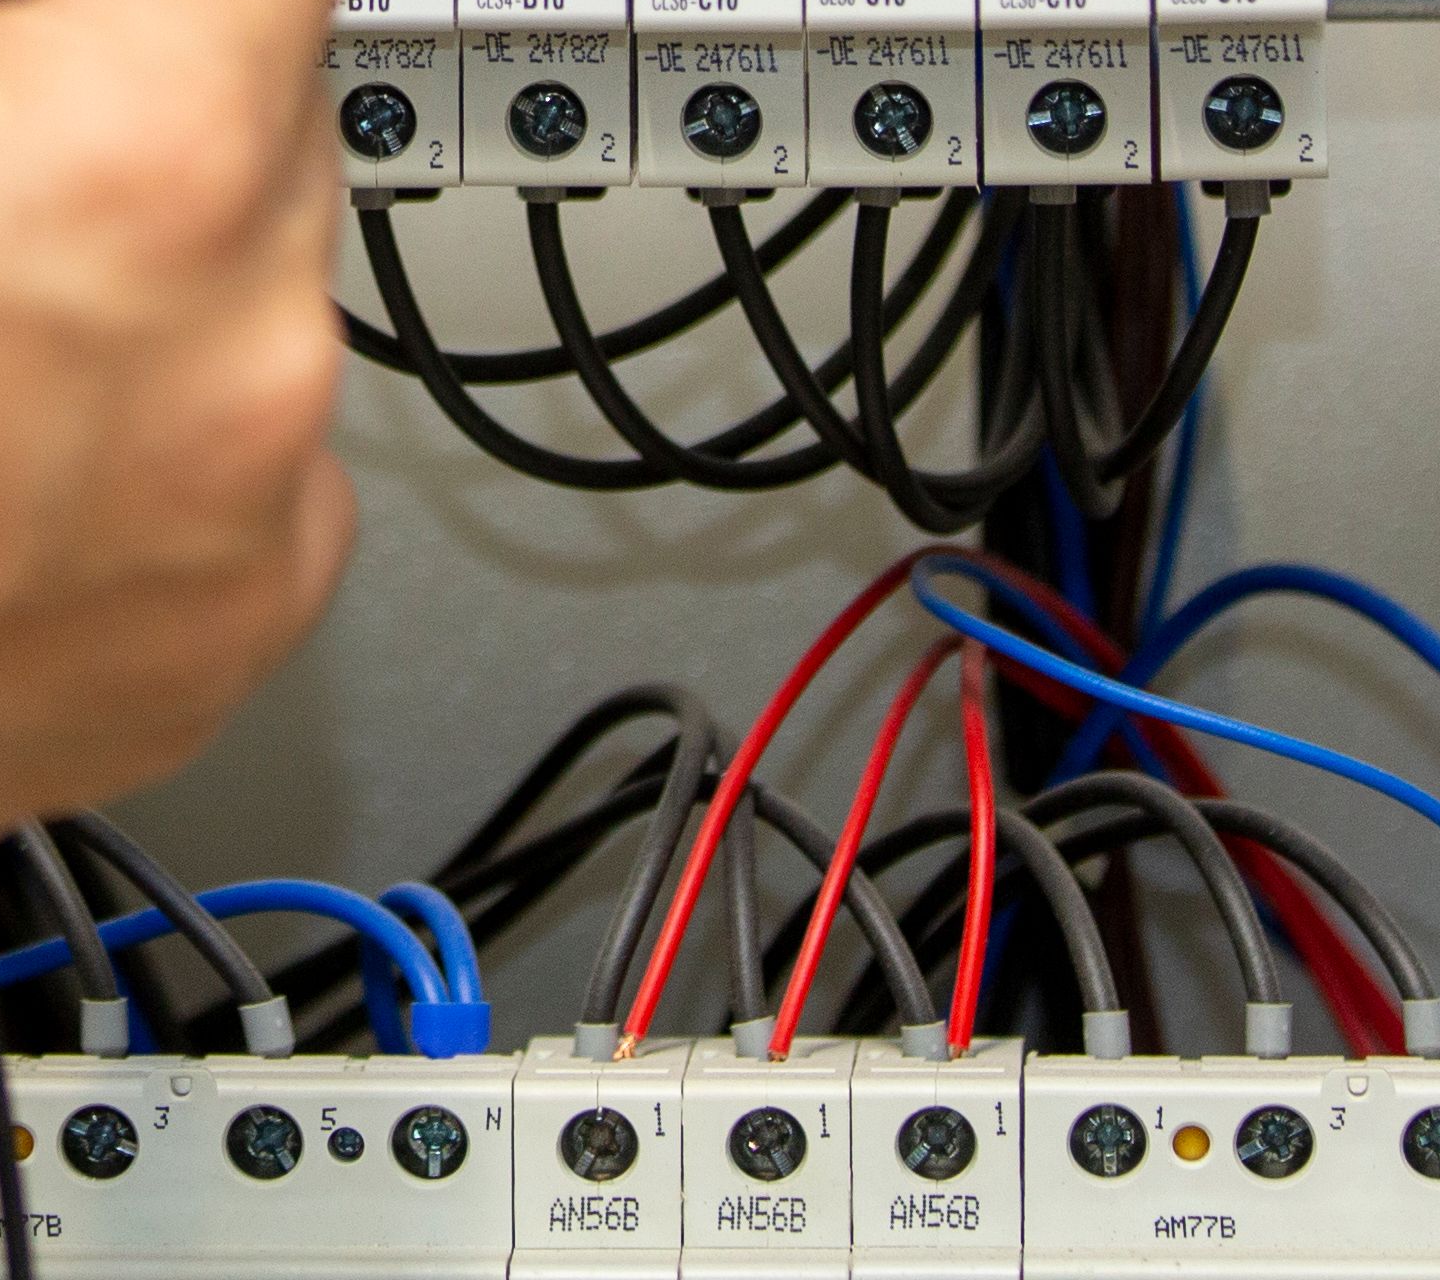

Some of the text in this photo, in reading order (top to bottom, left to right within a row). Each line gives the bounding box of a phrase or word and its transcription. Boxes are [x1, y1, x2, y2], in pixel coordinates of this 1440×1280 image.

[354, 38, 436, 69] 247827
[527, 32, 609, 63] 247827
[695, 44, 778, 73] 247611
[867, 36, 949, 66] 247611
[1044, 39, 1127, 68] 247611
[1221, 34, 1304, 63] 247611
[429, 140, 443, 169] 2
[600, 132, 615, 162] 2
[774, 145, 788, 174] 2
[947, 135, 962, 165] 2
[1124, 140, 1138, 169] 2
[1298, 134, 1313, 162] 2
[154, 1106, 169, 1129] 3
[321, 1108, 336, 1130] 5
[486, 1107, 501, 1130] N
[654, 1102, 665, 1136] 1
[819, 1103, 830, 1138] 1
[995, 1102, 1006, 1136] 1
[1155, 1106, 1163, 1129] 1
[1330, 1107, 1346, 1130] 3
[1155, 1216, 1236, 1238] AM77B
